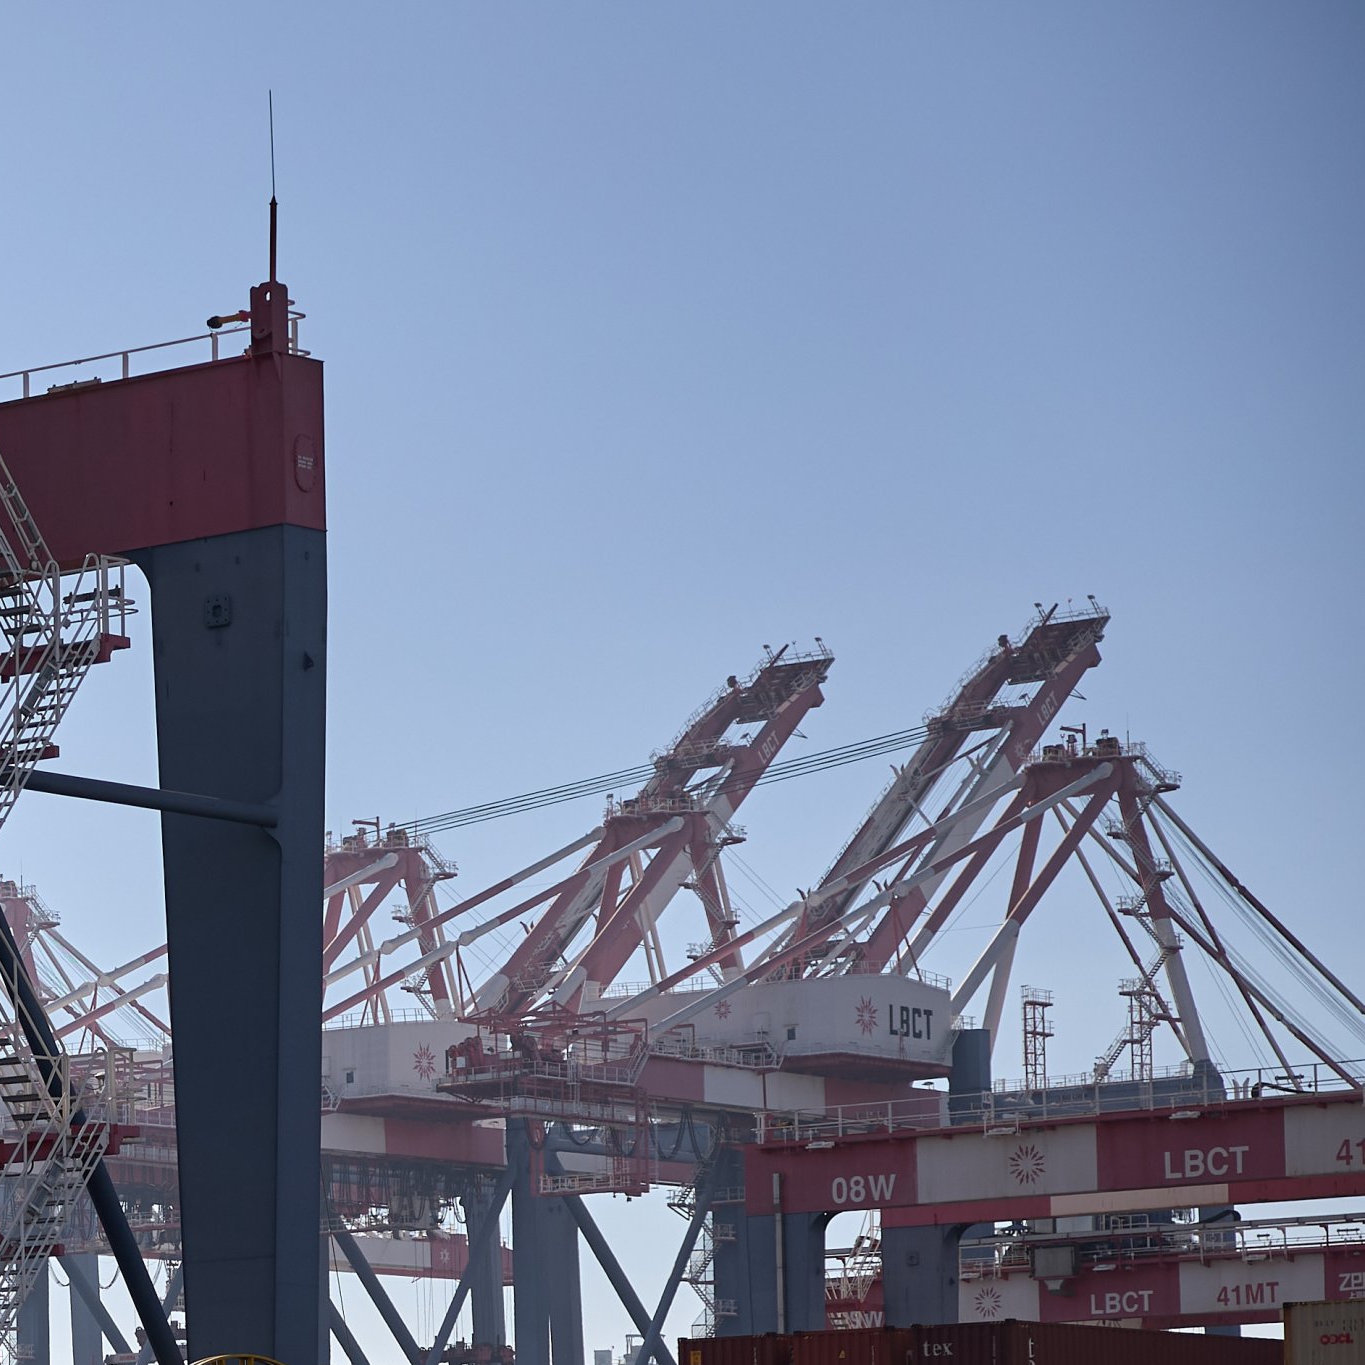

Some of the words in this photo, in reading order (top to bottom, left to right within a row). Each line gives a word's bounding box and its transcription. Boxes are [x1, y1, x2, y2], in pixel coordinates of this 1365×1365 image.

[889, 1004, 933, 1040] LBCT
[1164, 1145, 1249, 1179] LBCT
[831, 1173, 896, 1204] 08W
[1091, 1291, 1154, 1315] LBCT
[1217, 1283, 1279, 1306] 41MT
[923, 1340, 953, 1356] tex
